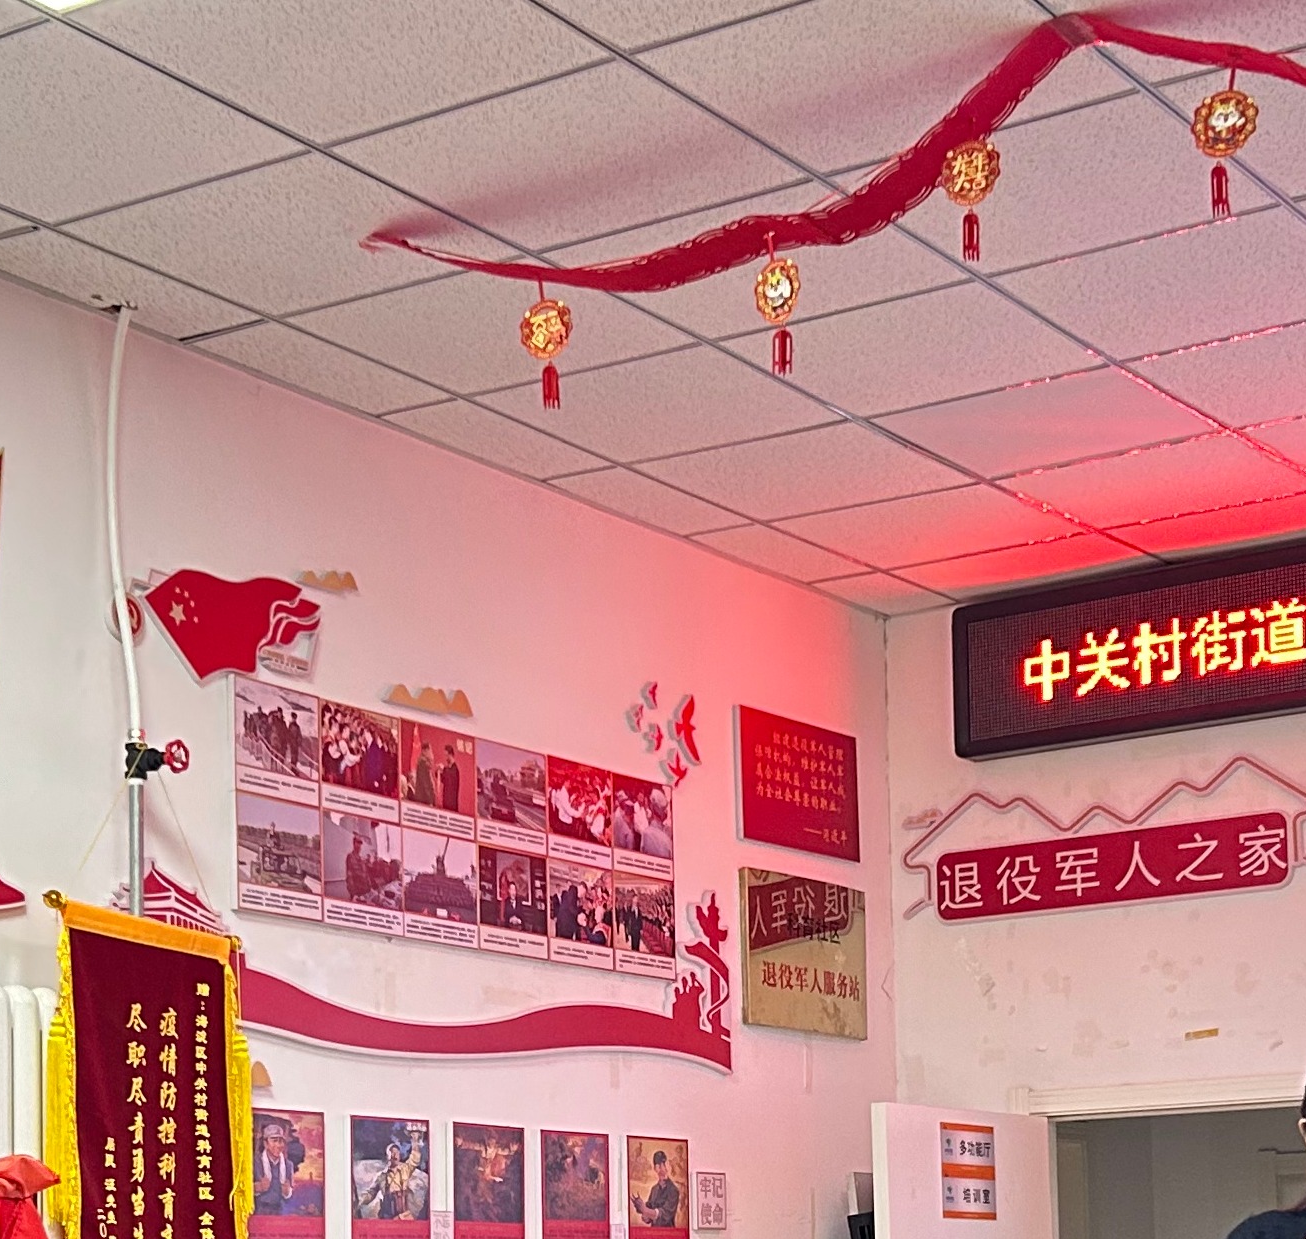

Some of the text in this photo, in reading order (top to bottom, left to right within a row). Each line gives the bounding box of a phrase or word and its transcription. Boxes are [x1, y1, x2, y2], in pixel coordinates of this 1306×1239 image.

[939, 825, 1288, 911] 退役军人之家
[761, 959, 860, 1002] 退役军人服务站
[959, 1140, 992, 1158] 多功能厅
[699, 1176, 724, 1200] 牢记
[962, 1188, 991, 1205] 培训室
[700, 1203, 724, 1226] 使命
